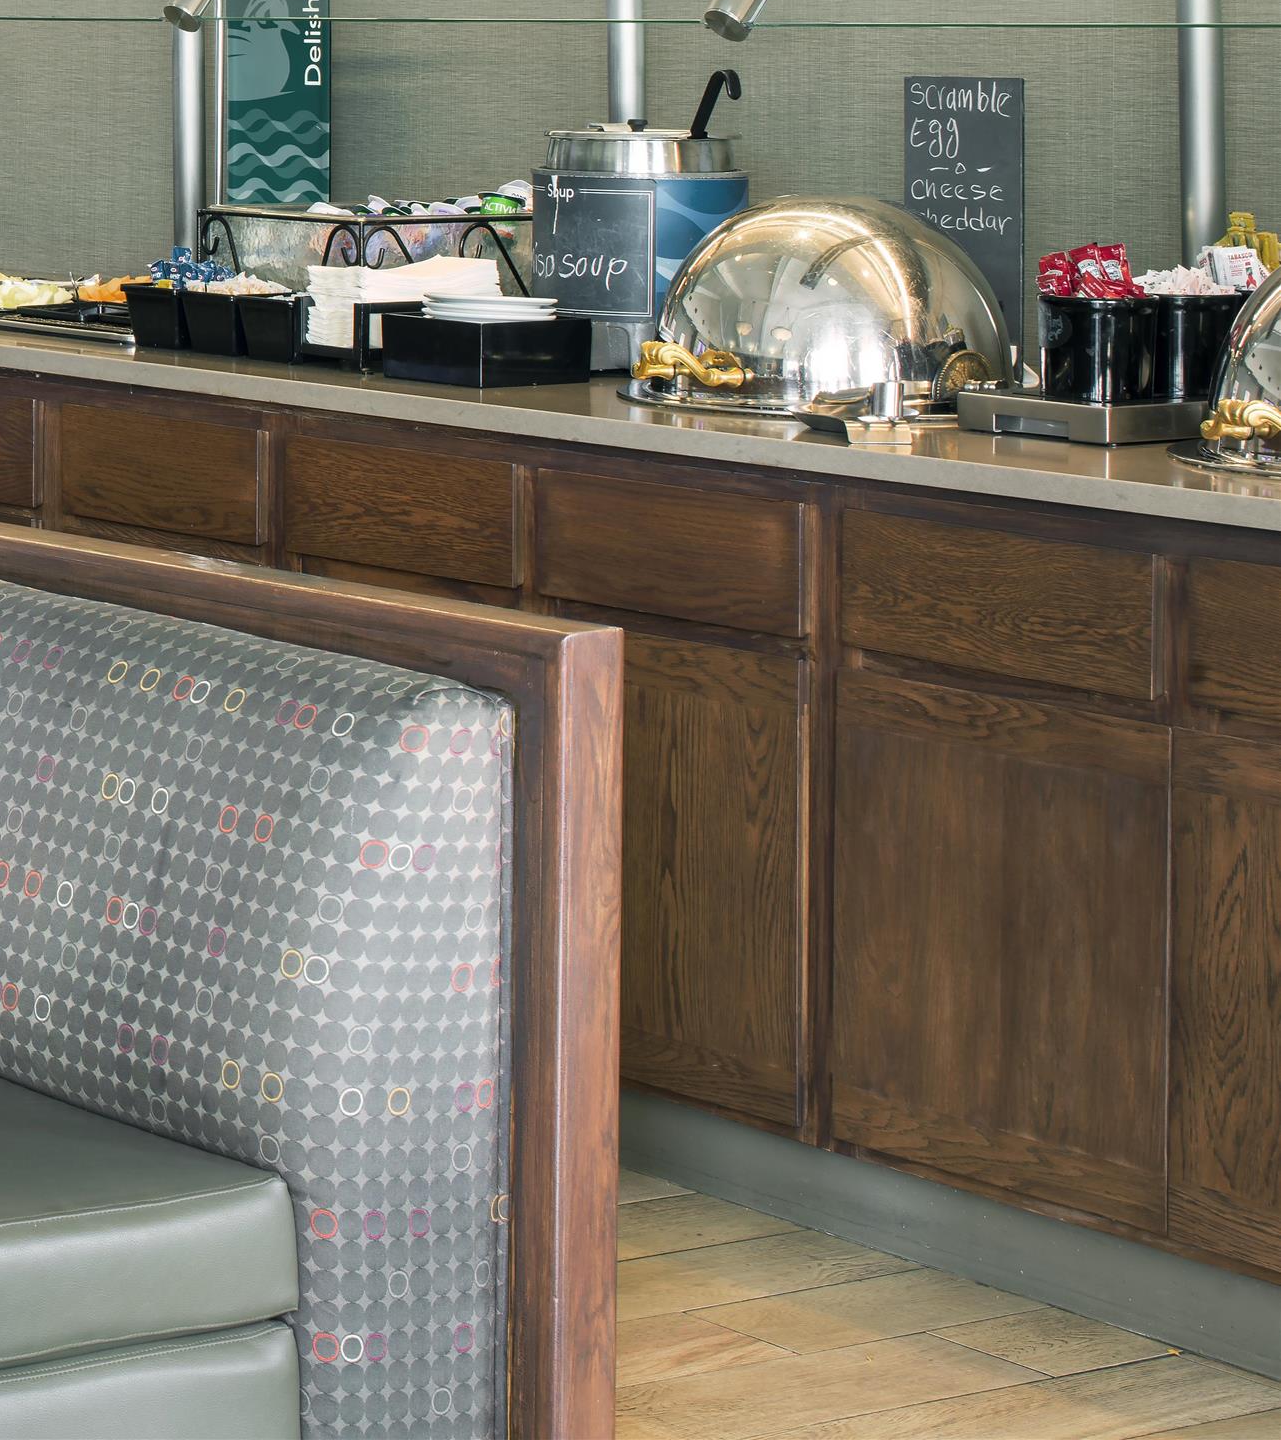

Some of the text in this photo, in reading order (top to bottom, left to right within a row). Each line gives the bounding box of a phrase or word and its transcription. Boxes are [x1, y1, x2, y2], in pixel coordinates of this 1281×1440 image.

[910, 117, 959, 159] Egg
[547, 183, 575, 203] Soup
[920, 206, 1012, 235] heddar
[1227, 252, 1253, 261] TABASCO
